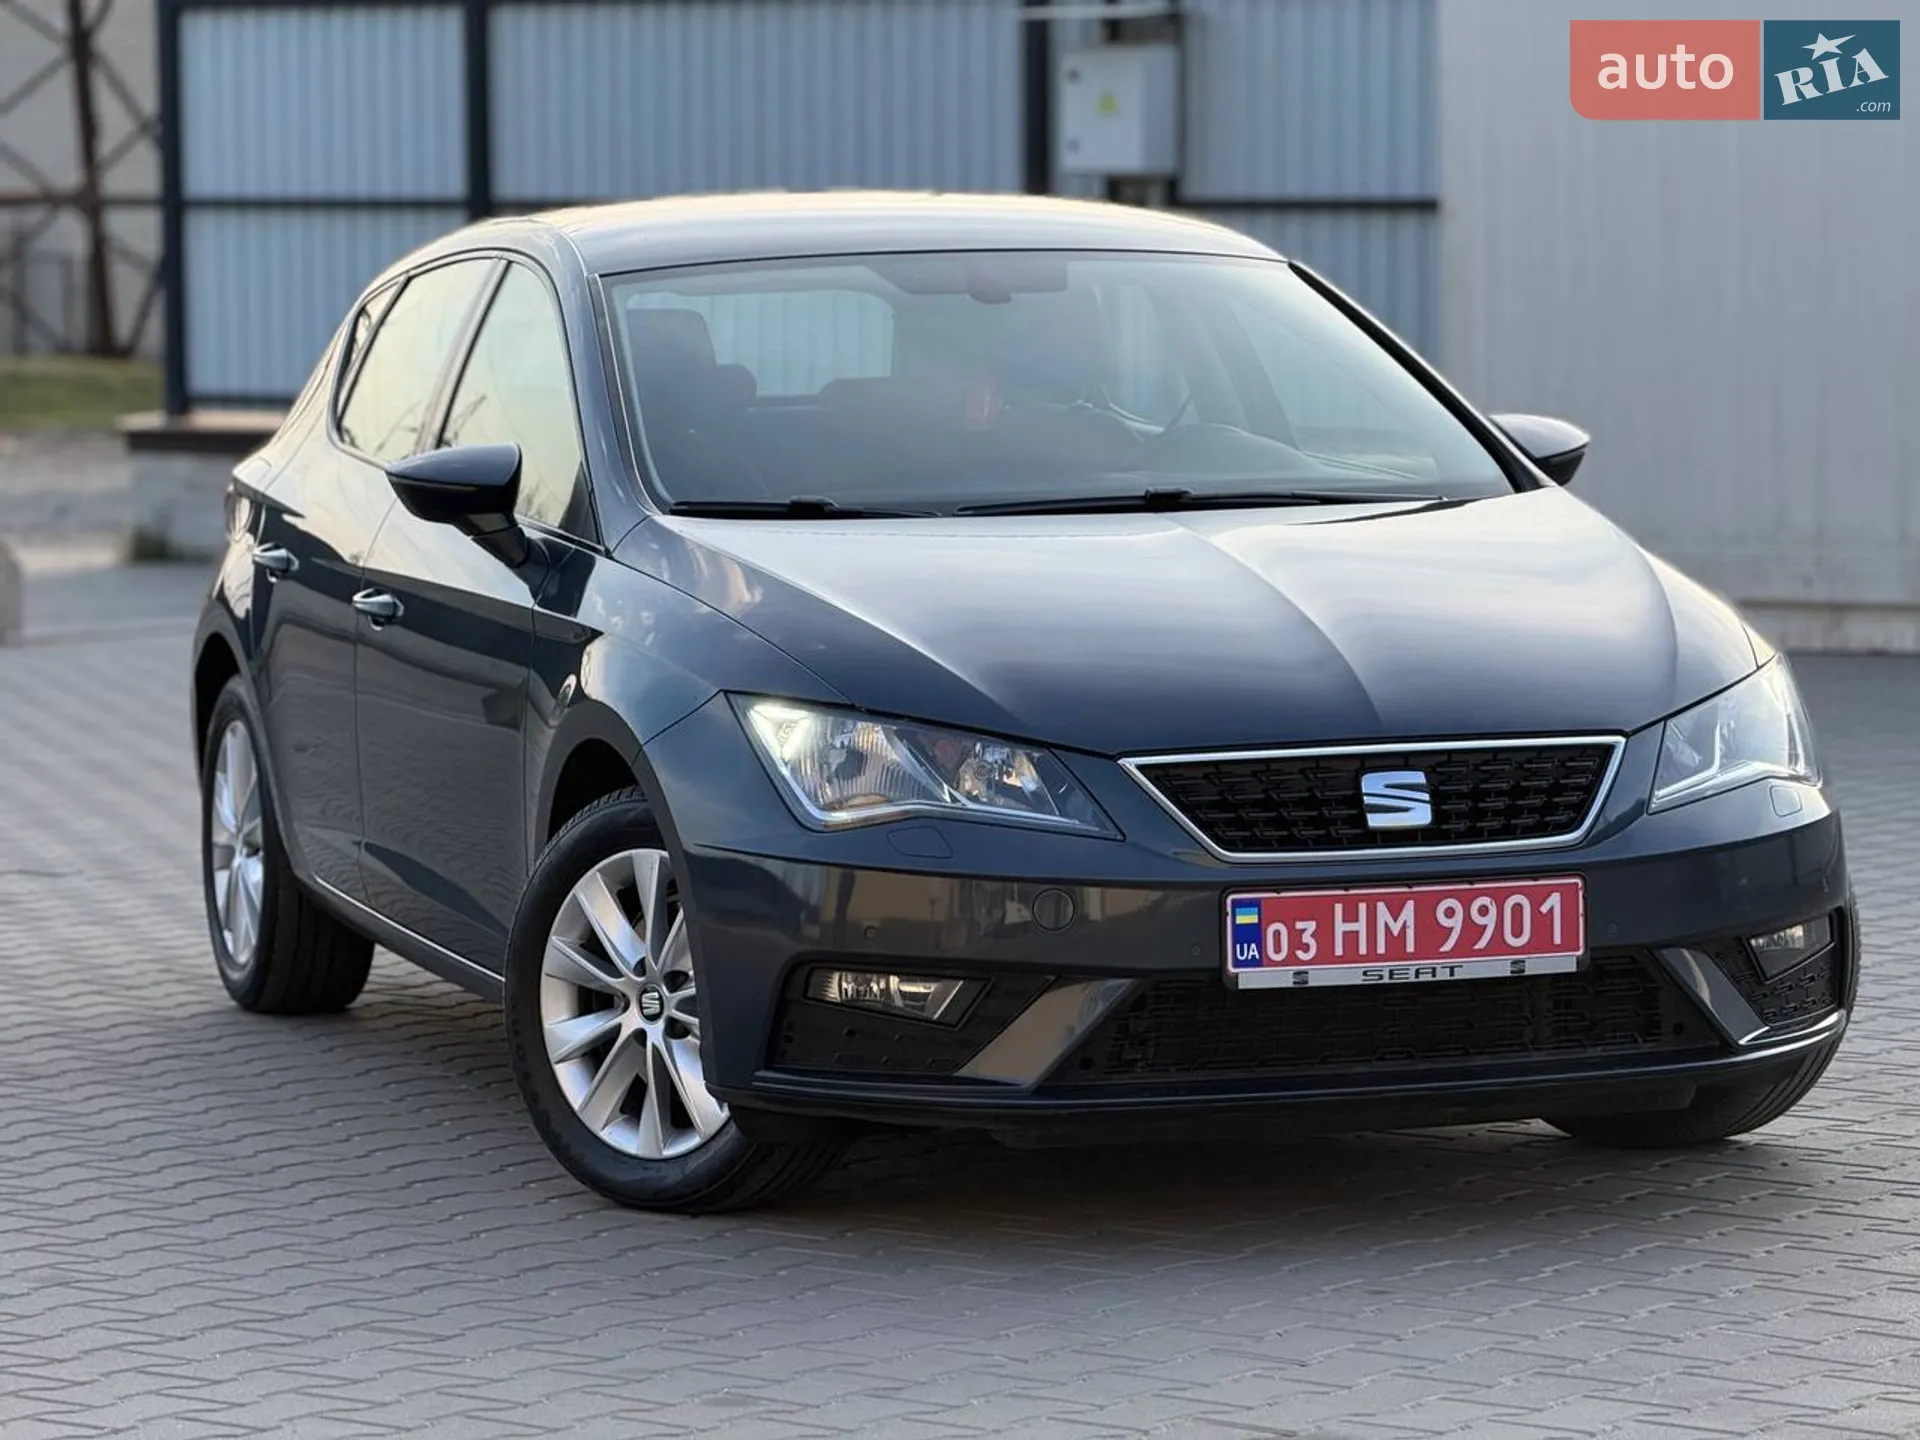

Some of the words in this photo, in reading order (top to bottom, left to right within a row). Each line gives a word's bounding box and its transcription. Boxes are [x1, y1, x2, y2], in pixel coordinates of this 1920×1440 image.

[1266, 921, 1317, 962] 03
[1334, 901, 1415, 956] HM
[1435, 892, 1562, 952] 9901
[1236, 943, 1260, 960] UA
[1361, 964, 1463, 983] SEAT
